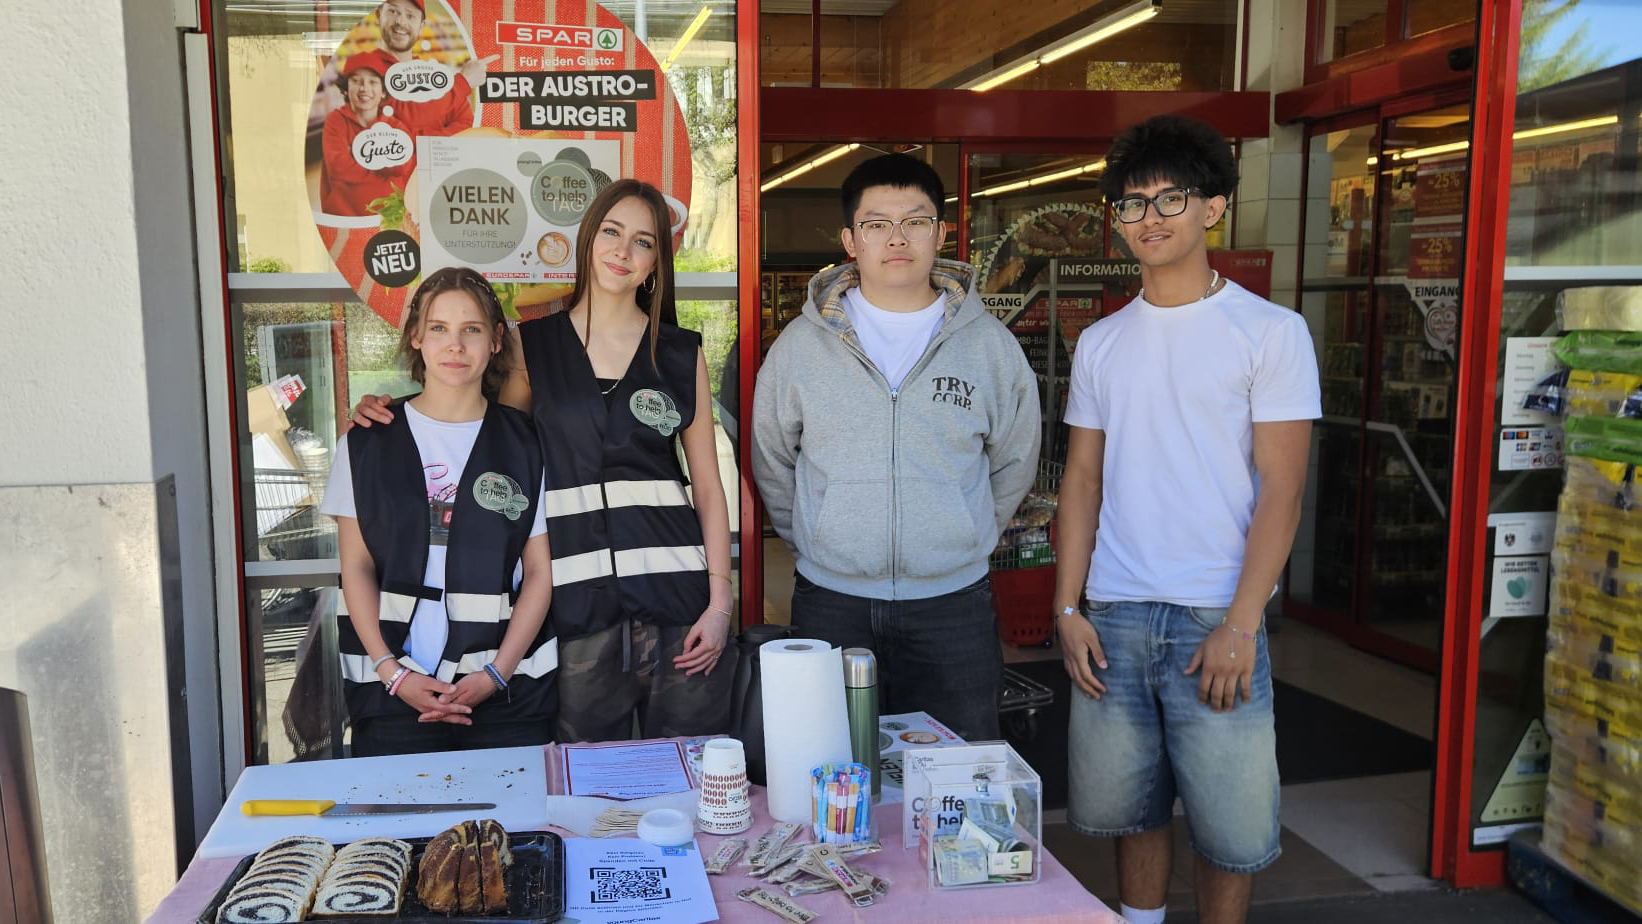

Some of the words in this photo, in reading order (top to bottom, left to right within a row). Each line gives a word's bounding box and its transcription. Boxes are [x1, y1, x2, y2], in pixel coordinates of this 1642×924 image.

[516, 27, 592, 45] SPAR
[519, 56, 538, 67] Für
[541, 56, 574, 69] jeden
[577, 56, 615, 66] Gusto:
[390, 71, 448, 91] GUSTO
[486, 76, 536, 98] DER
[540, 74, 648, 97] AUSTRO-
[531, 105, 627, 127] BURGER
[360, 139, 404, 164] Gusto
[442, 185, 515, 204] VIELEN
[541, 189, 556, 202] to
[558, 189, 587, 205] help
[549, 196, 585, 212] TAG
[449, 207, 511, 225] DANK
[462, 229, 478, 238] FÜR
[480, 230, 499, 238] IHRE
[373, 241, 407, 256] JETZT
[444, 239, 516, 249] UNTERSTÜTZUNG!
[371, 252, 416, 276] NEU
[932, 376, 976, 397] TRV
[932, 392, 972, 411] CORP.
[1010, 855, 1020, 869] 5
